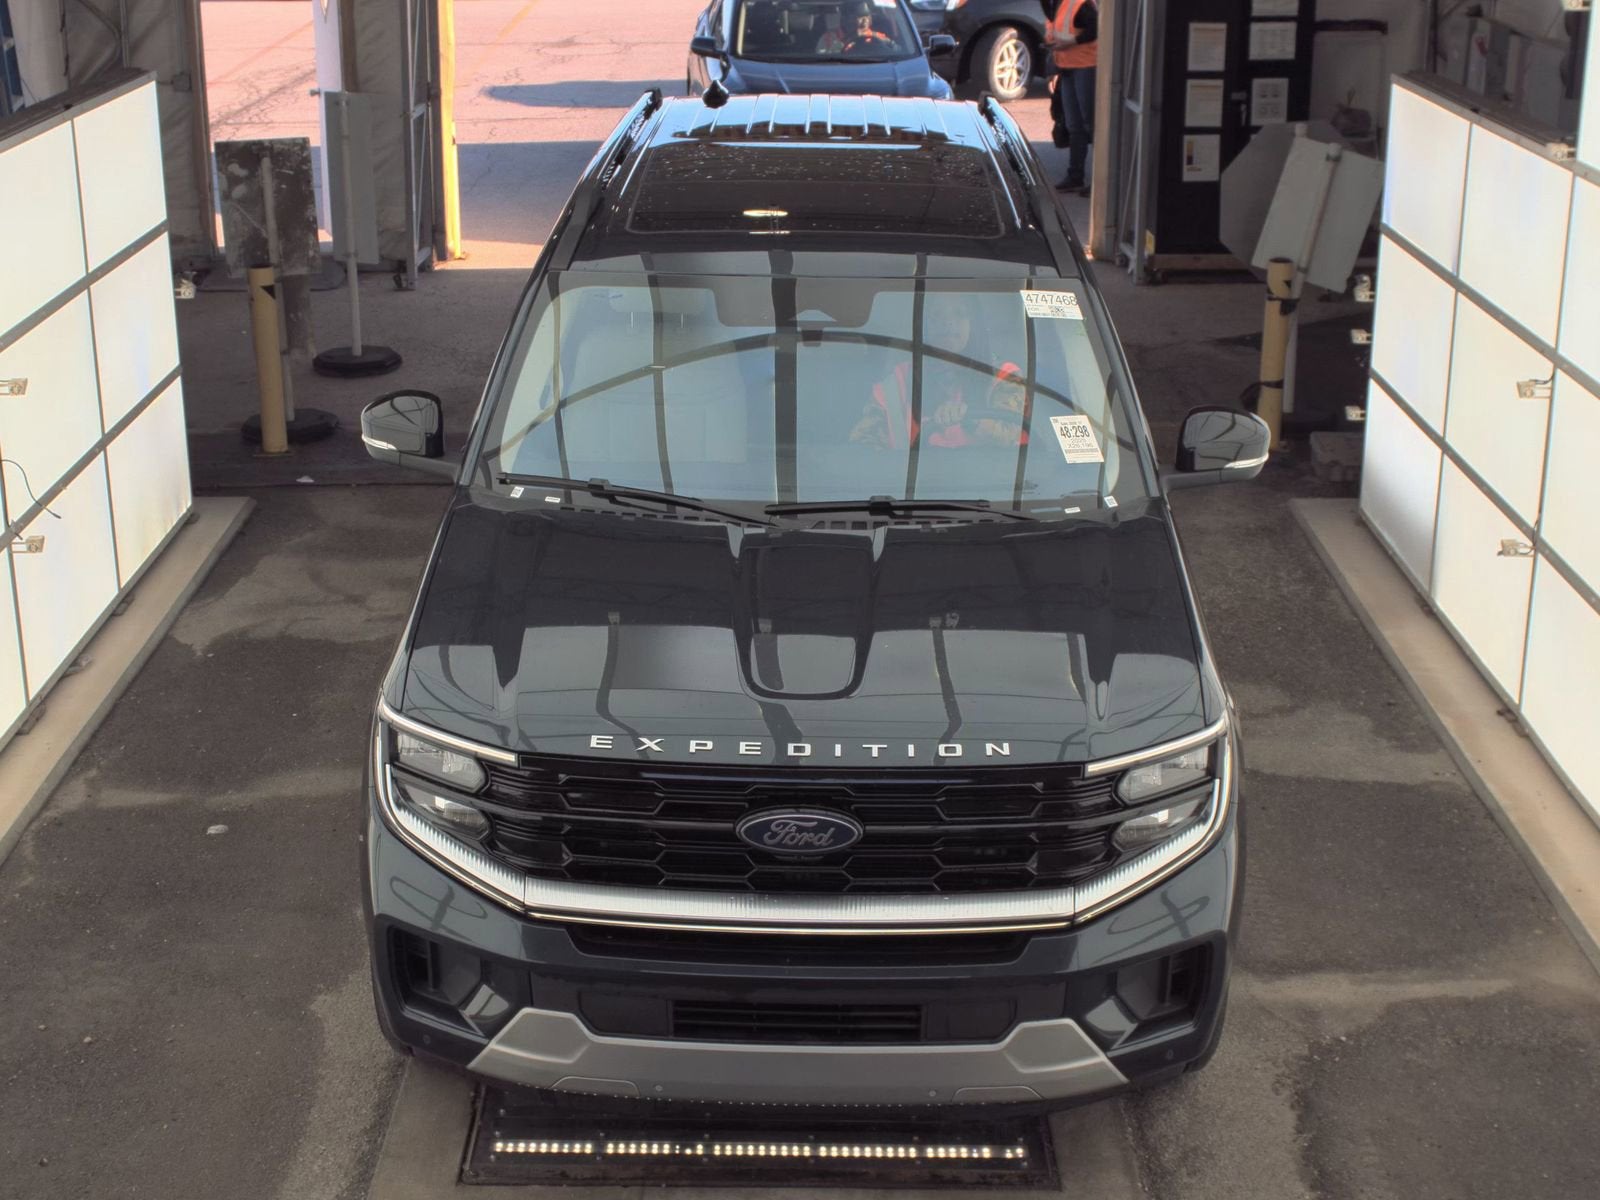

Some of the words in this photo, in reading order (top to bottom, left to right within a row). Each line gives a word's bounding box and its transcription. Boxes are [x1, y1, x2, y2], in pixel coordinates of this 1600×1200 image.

[1025, 293, 1078, 306] 4747468
[590, 735, 1010, 757] EXPEDITION
[763, 819, 835, 846] Ford
